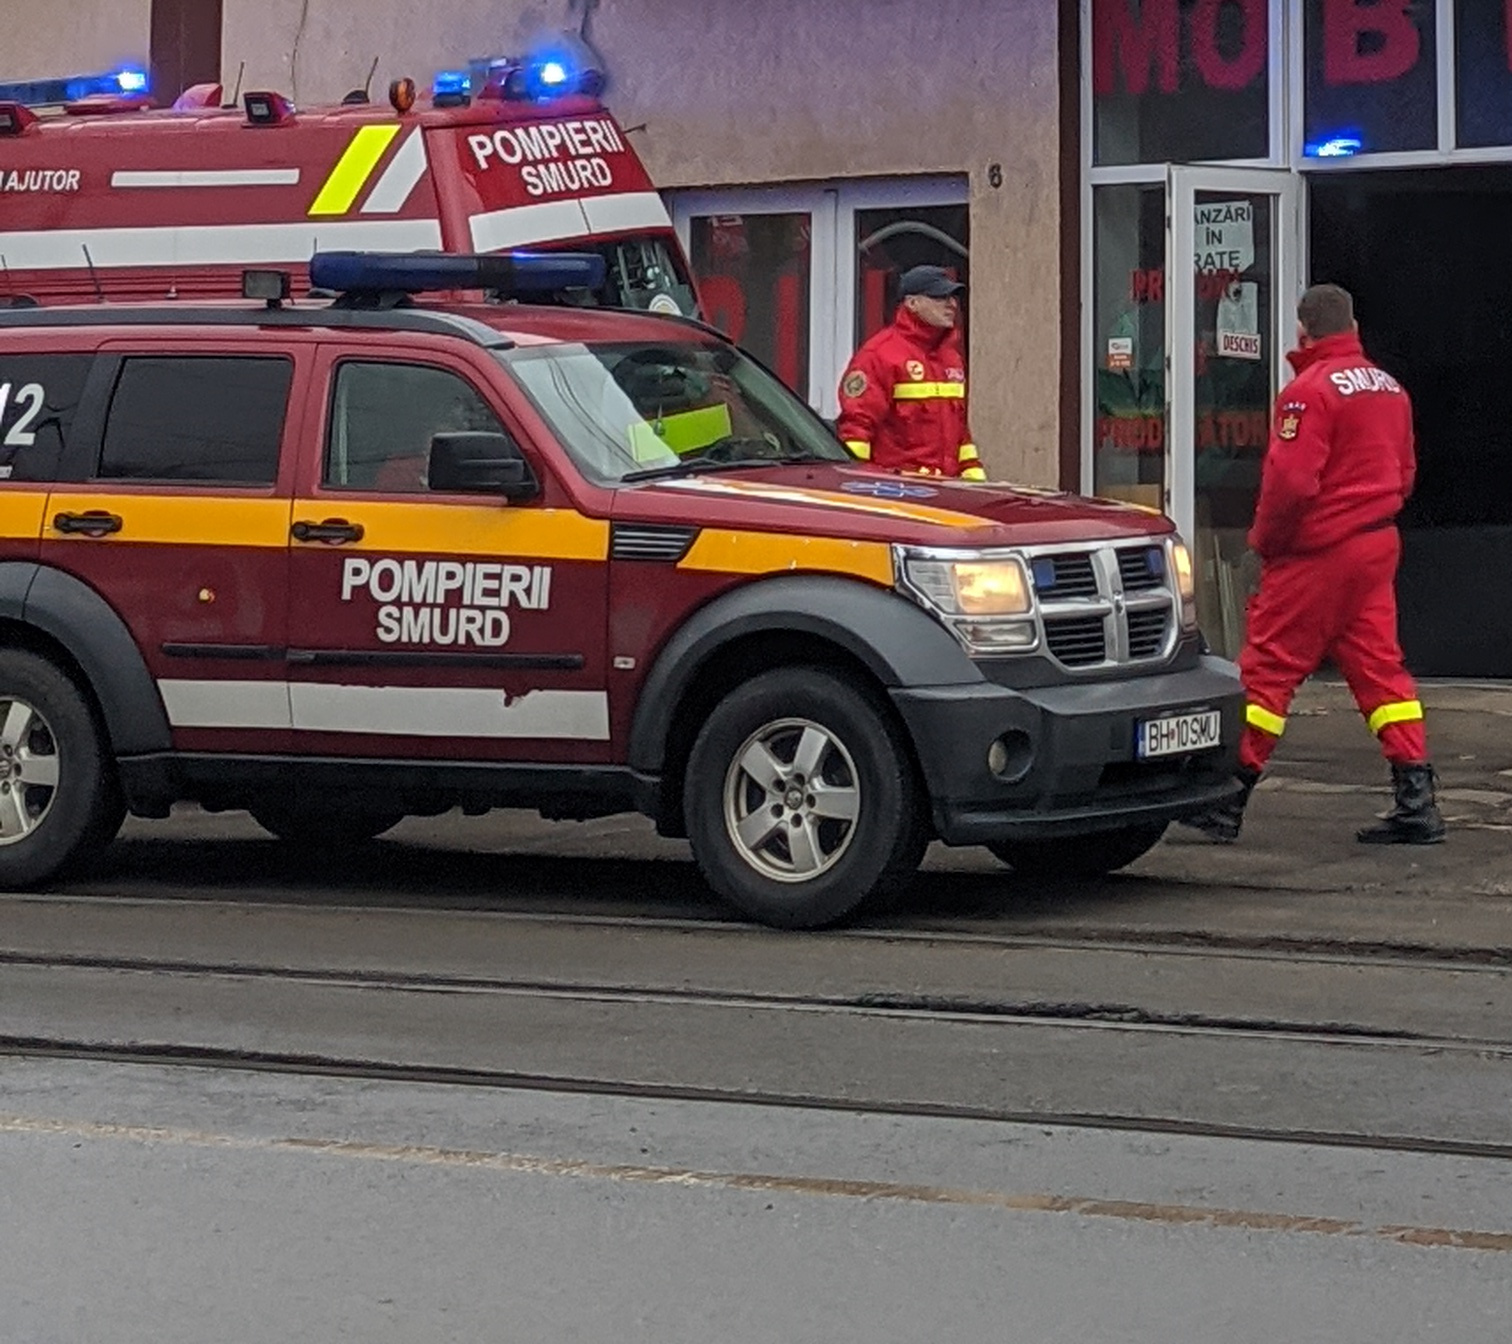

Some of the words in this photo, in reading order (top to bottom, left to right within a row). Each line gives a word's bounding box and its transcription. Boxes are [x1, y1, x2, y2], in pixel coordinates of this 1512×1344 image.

[468, 120, 625, 170] POMPIERII
[4, 169, 81, 192] AJUTOR
[521, 158, 613, 196] SMURD
[1223, 332, 1259, 355] DESCHIS
[341, 558, 552, 610] POMPIERII
[376, 604, 511, 647] SMURD
